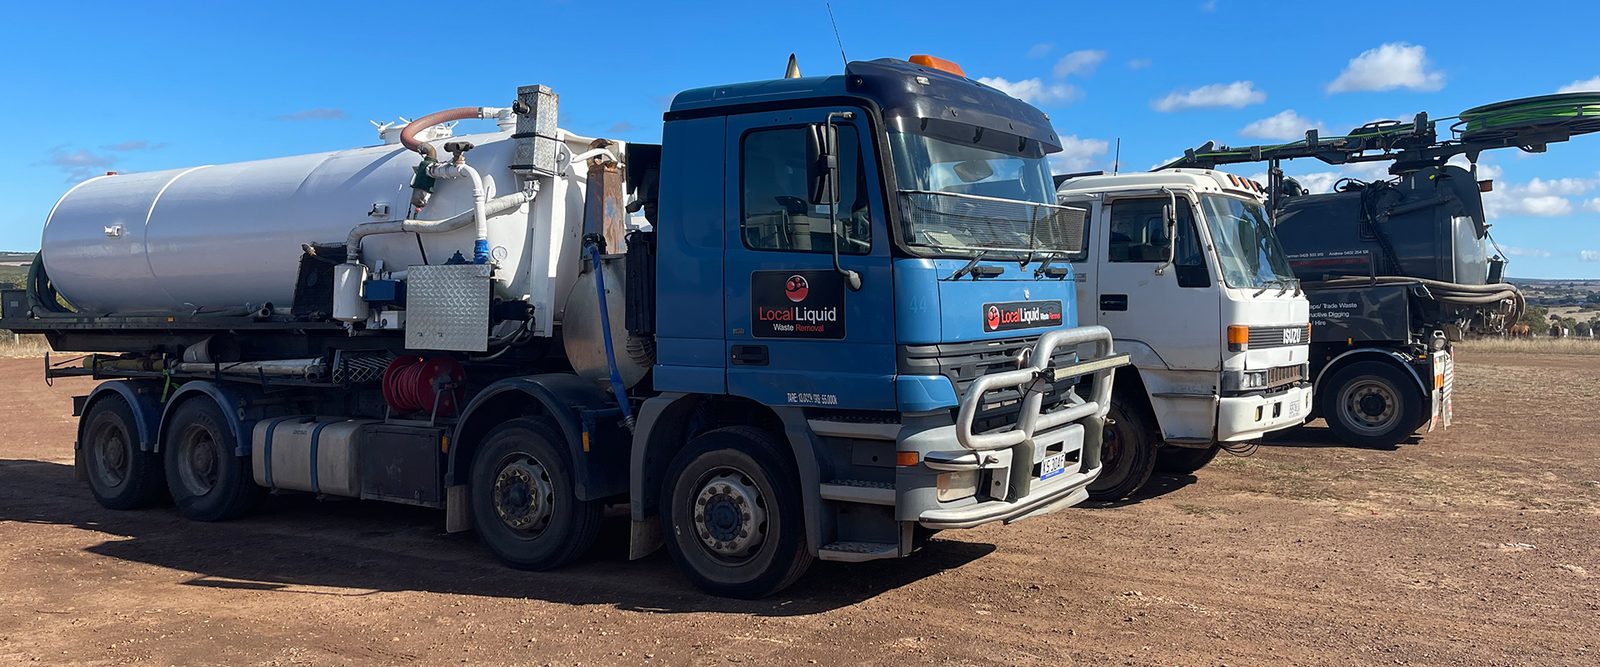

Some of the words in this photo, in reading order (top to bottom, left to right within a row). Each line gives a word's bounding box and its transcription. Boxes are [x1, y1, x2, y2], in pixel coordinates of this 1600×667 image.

[759, 306, 794, 321] Local
[795, 306, 837, 325] Liquid
[1001, 308, 1020, 324] Local
[1020, 307, 1040, 325] Liquid
[773, 323, 795, 332] Waste
[795, 324, 825, 332] Removal
[1283, 328, 1301, 344] ISUZU
